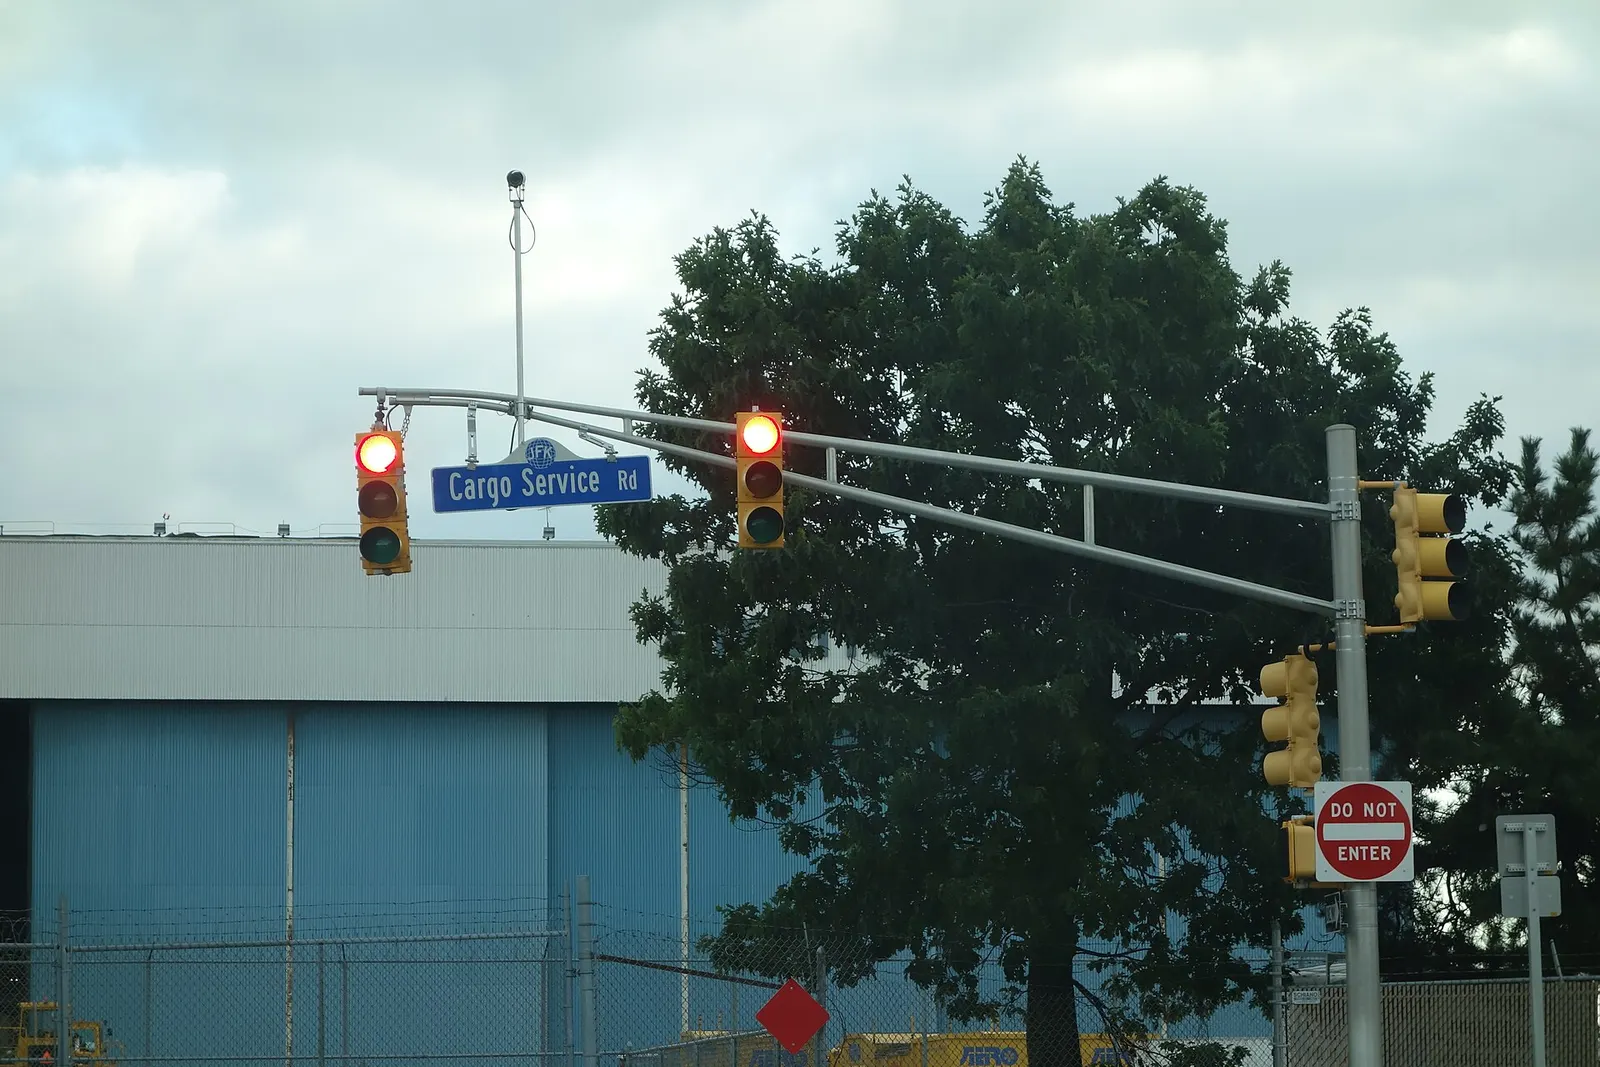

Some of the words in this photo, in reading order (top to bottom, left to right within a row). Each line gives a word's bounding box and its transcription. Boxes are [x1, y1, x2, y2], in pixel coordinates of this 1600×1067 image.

[529, 445, 553, 460] JFK
[449, 472, 512, 508] Cargo
[521, 465, 600, 497] Service
[618, 469, 638, 491] Rd
[1331, 802, 1353, 818] DO
[1363, 802, 1397, 818] NOT
[1338, 846, 1391, 861] ENTER
